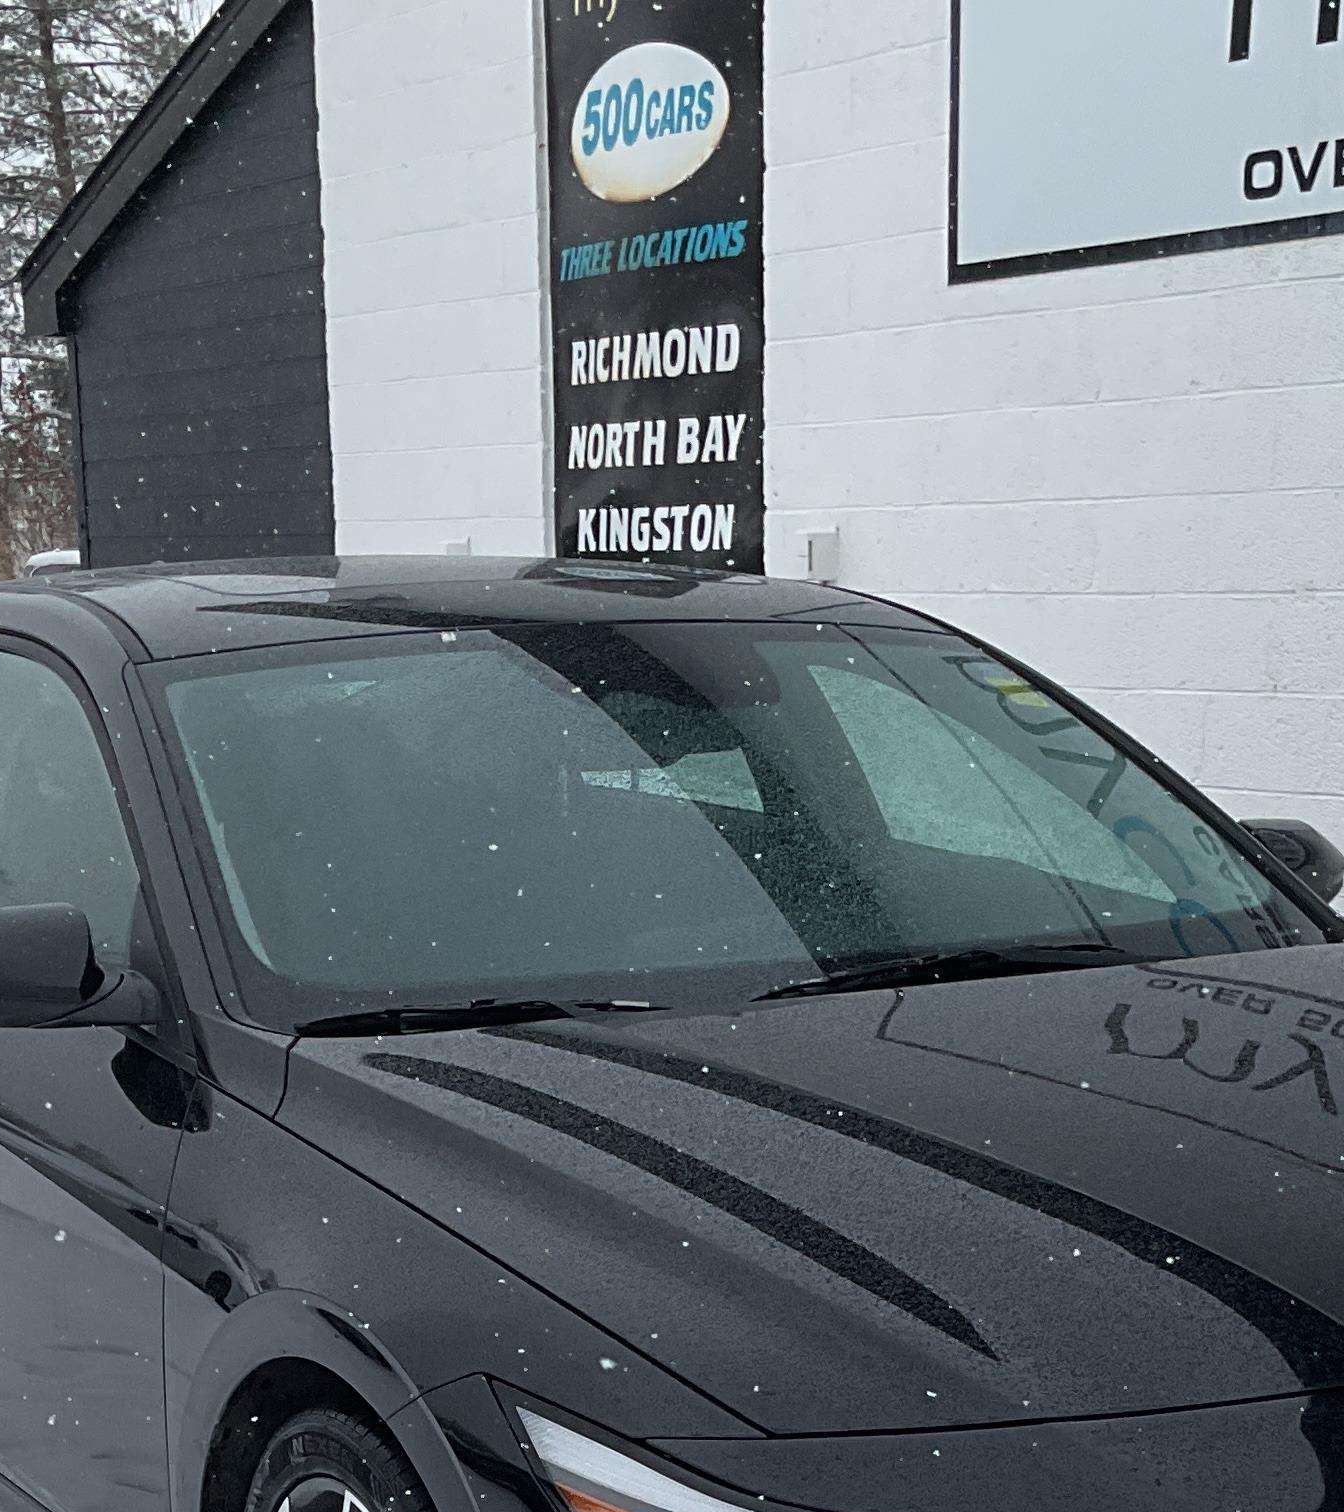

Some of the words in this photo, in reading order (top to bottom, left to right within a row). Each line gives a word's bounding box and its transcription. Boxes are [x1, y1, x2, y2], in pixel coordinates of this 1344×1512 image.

[560, 238, 616, 281] THREE
[617, 220, 748, 272] LOCATIONS
[571, 324, 740, 386] RICHMOND
[568, 419, 666, 470] NORTH
[677, 413, 746, 466] BAY
[577, 503, 734, 552] KINGSTON
